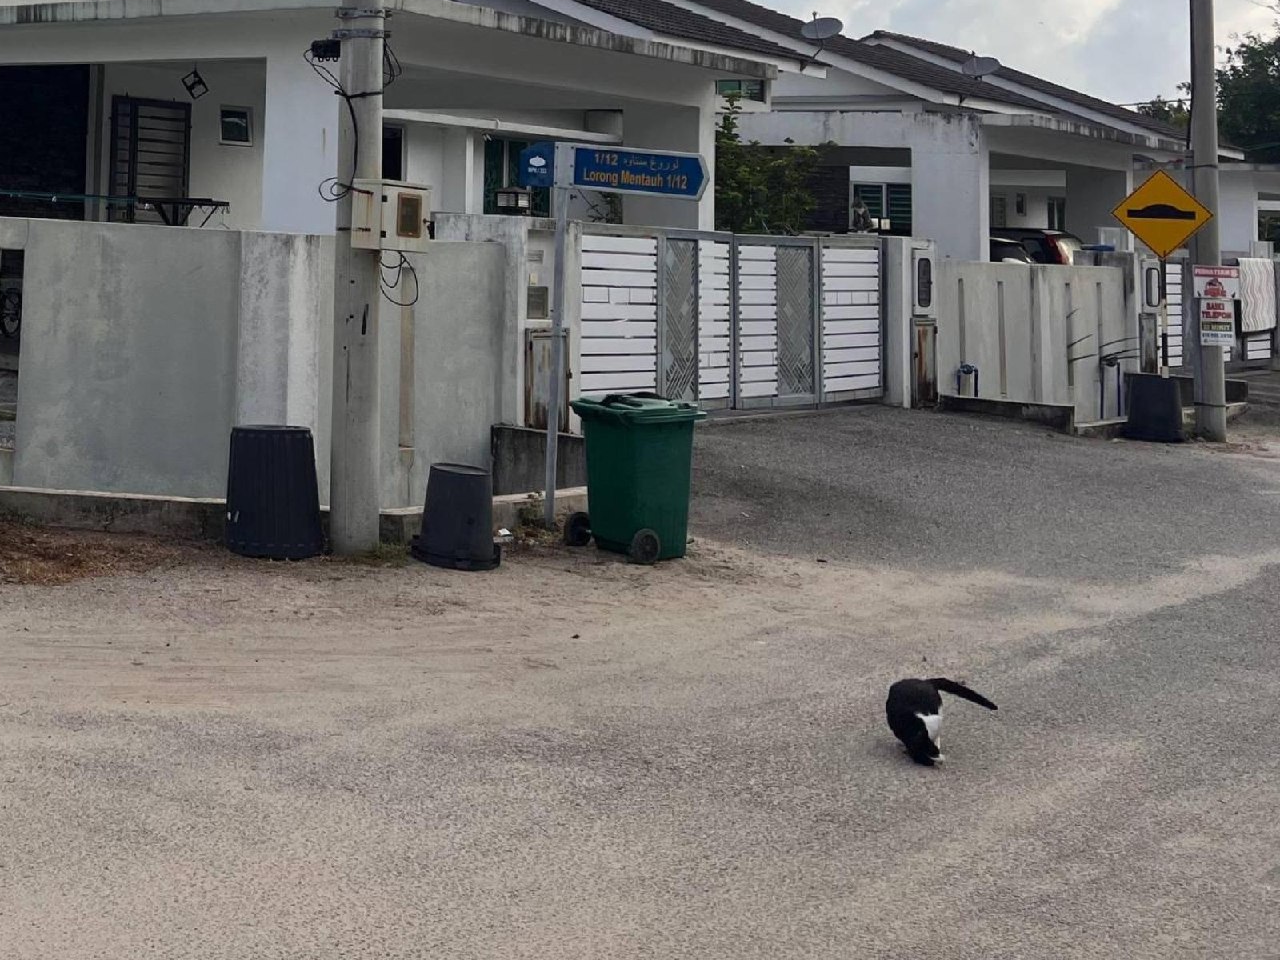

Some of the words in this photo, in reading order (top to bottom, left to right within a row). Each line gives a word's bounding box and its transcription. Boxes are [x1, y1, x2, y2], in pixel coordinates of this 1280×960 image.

[583, 168, 618, 186] Lorong
[621, 170, 663, 187] Mentauh
[667, 174, 688, 190] 1/12
